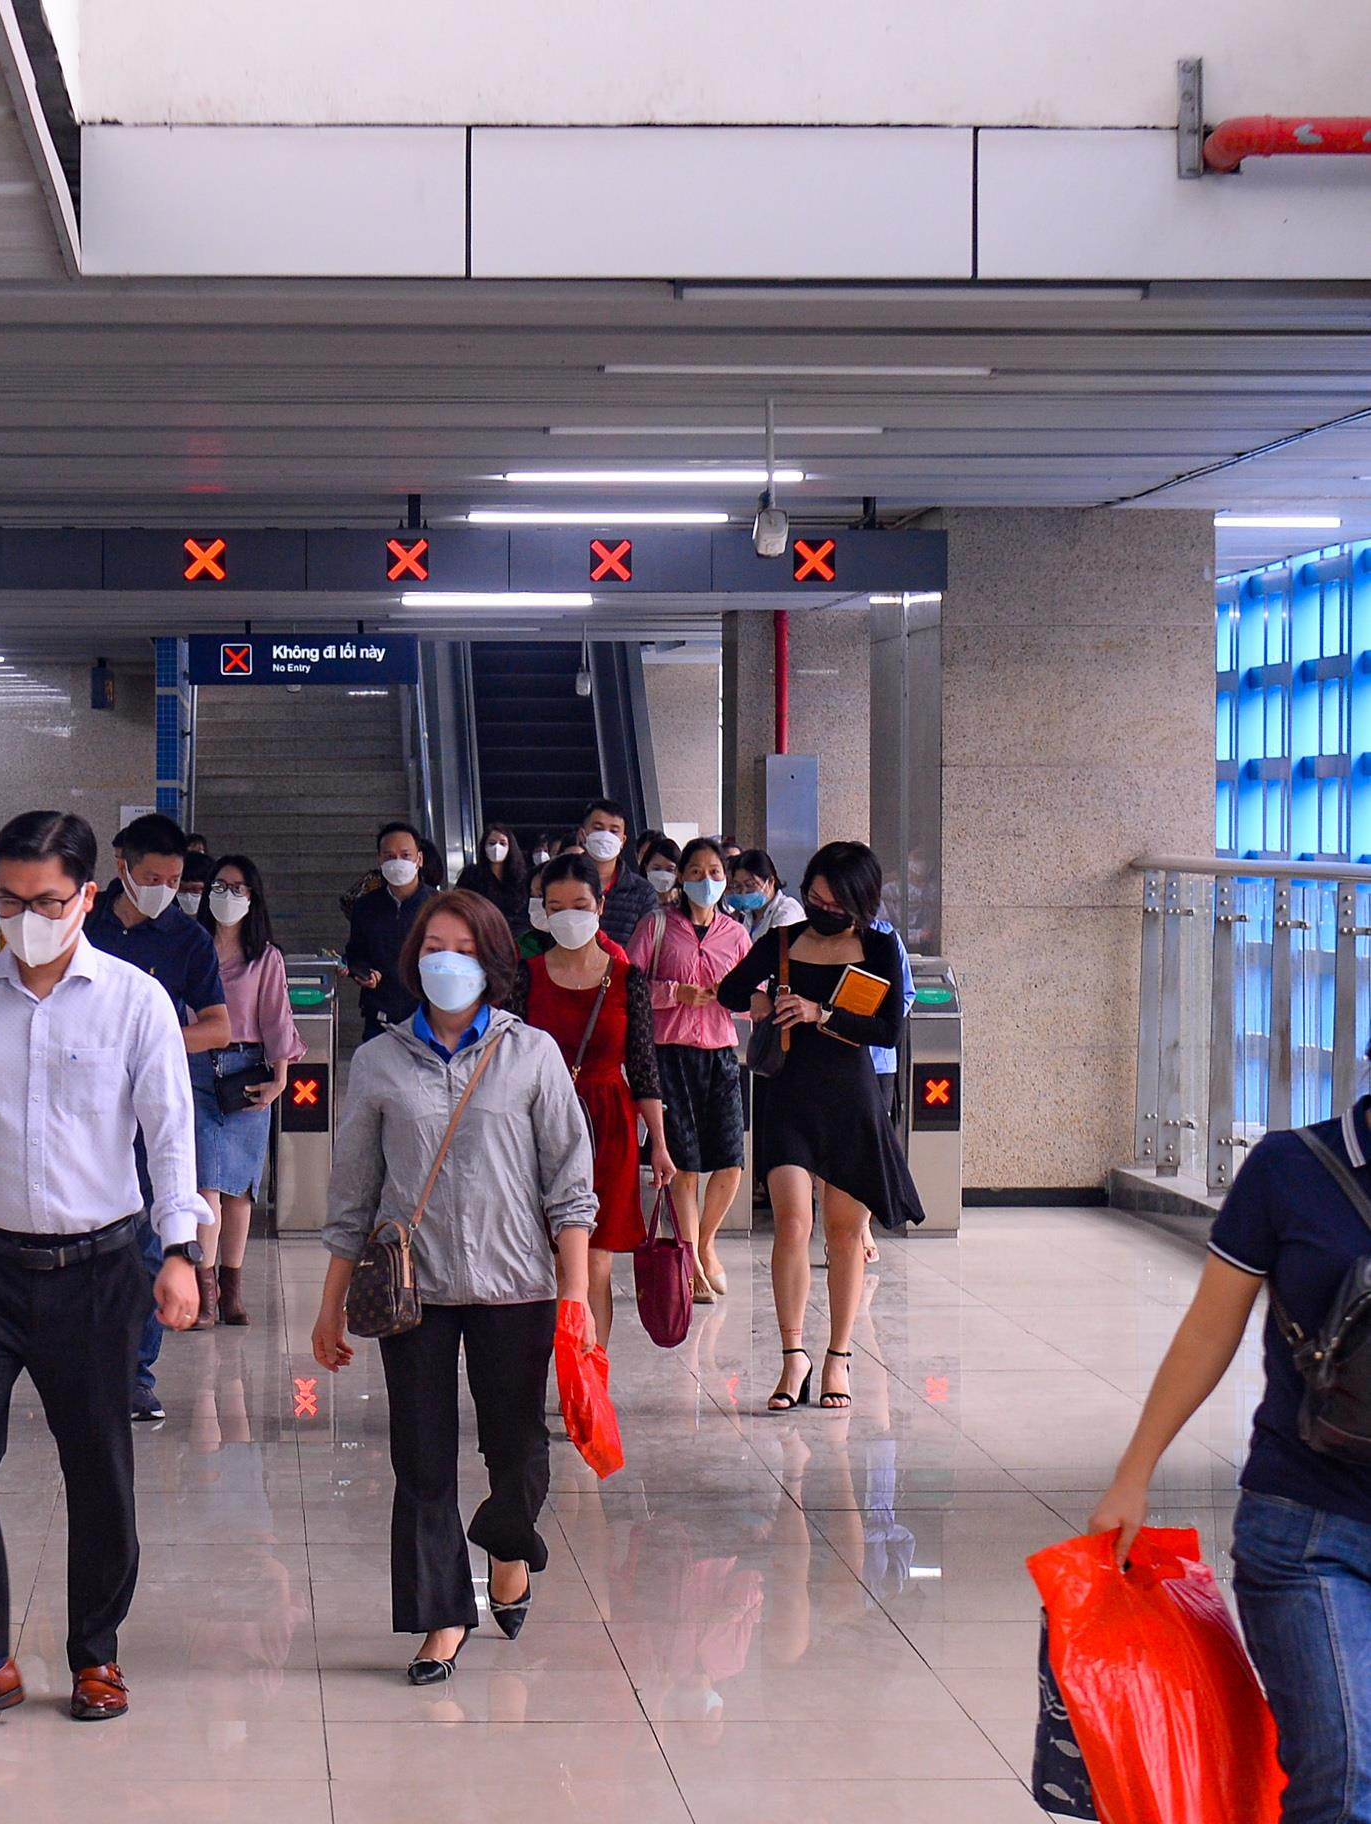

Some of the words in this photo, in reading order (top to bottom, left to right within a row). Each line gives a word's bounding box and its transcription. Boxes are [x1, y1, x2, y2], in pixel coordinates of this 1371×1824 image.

[272, 643, 320, 662] Không
[322, 644, 337, 660] đi
[339, 641, 357, 660] lối
[359, 643, 386, 662] này
[272, 663, 286, 672] No
[287, 663, 311, 674] Entry
